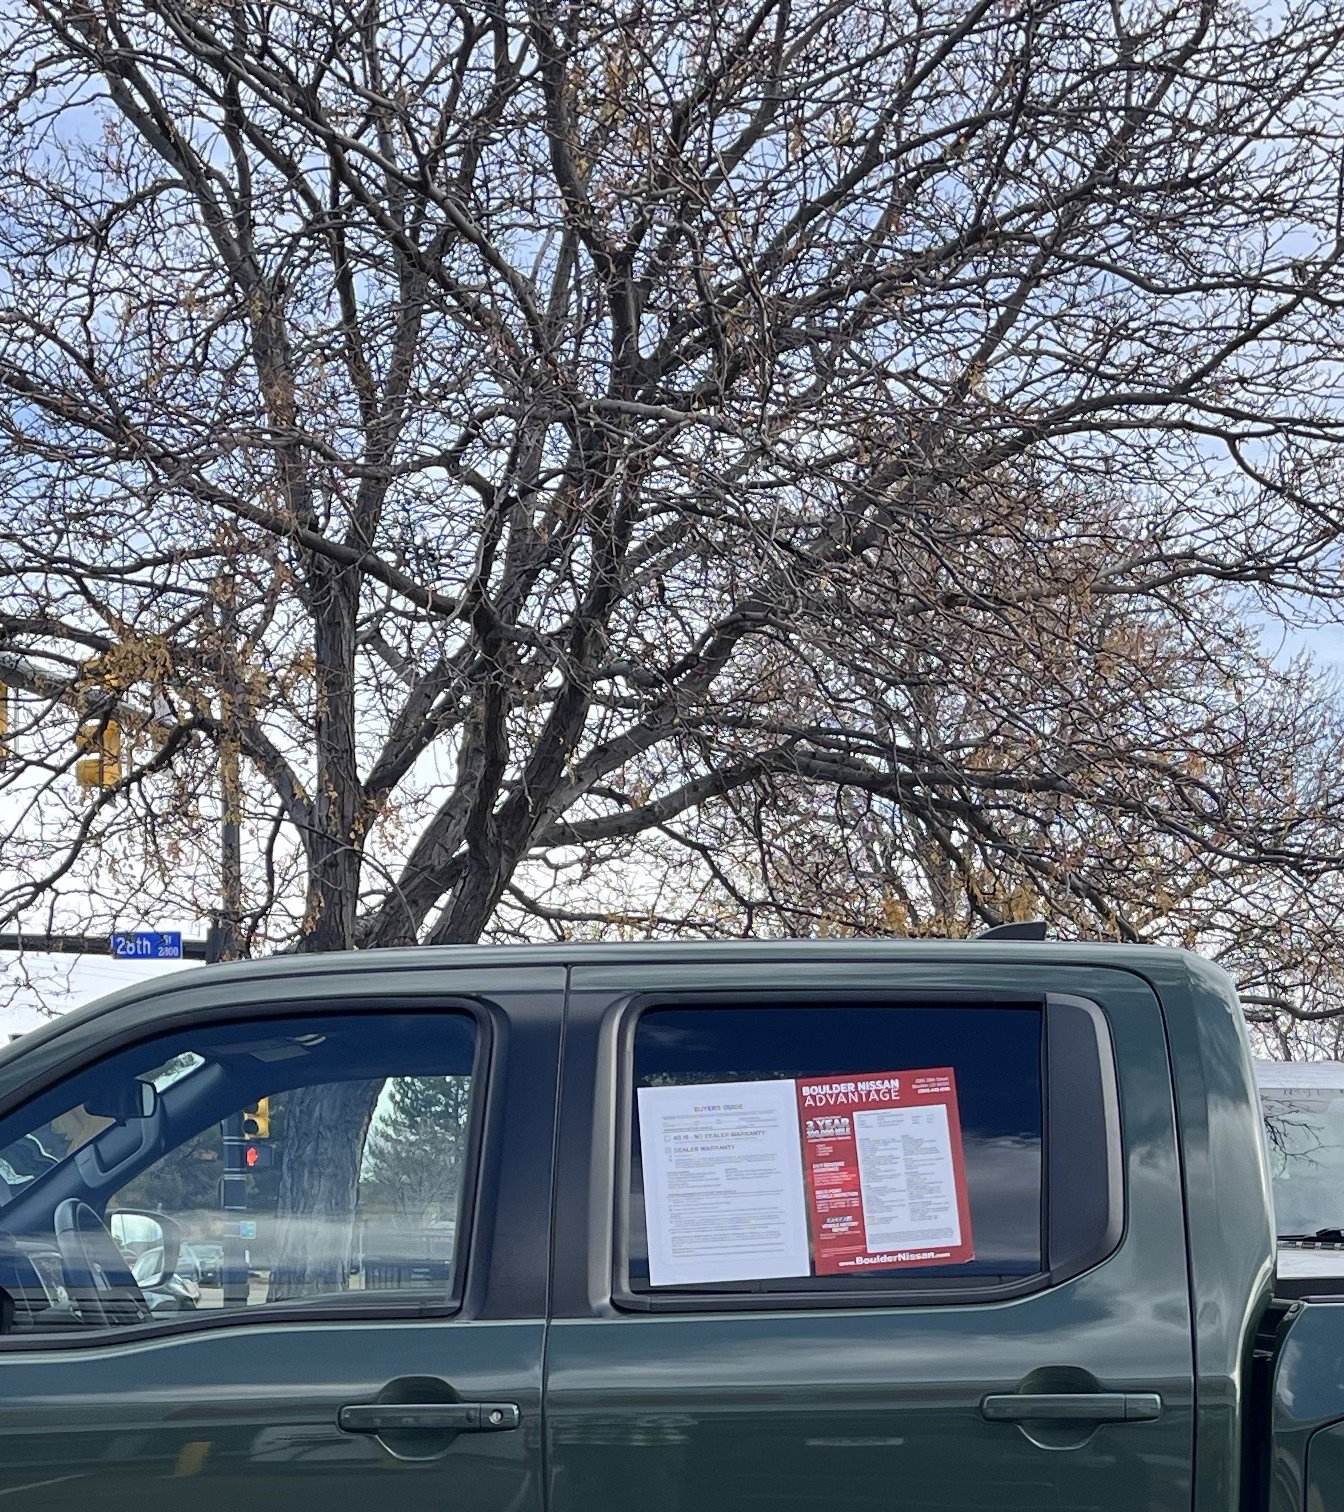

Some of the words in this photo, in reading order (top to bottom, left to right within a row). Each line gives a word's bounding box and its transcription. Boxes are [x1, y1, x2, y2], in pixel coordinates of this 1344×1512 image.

[802, 1082, 855, 1096] BOULDER
[857, 1079, 900, 1092] NISSAN
[804, 1088, 901, 1107] ADVANTAGE
[816, 1118, 849, 1130] YEAR
